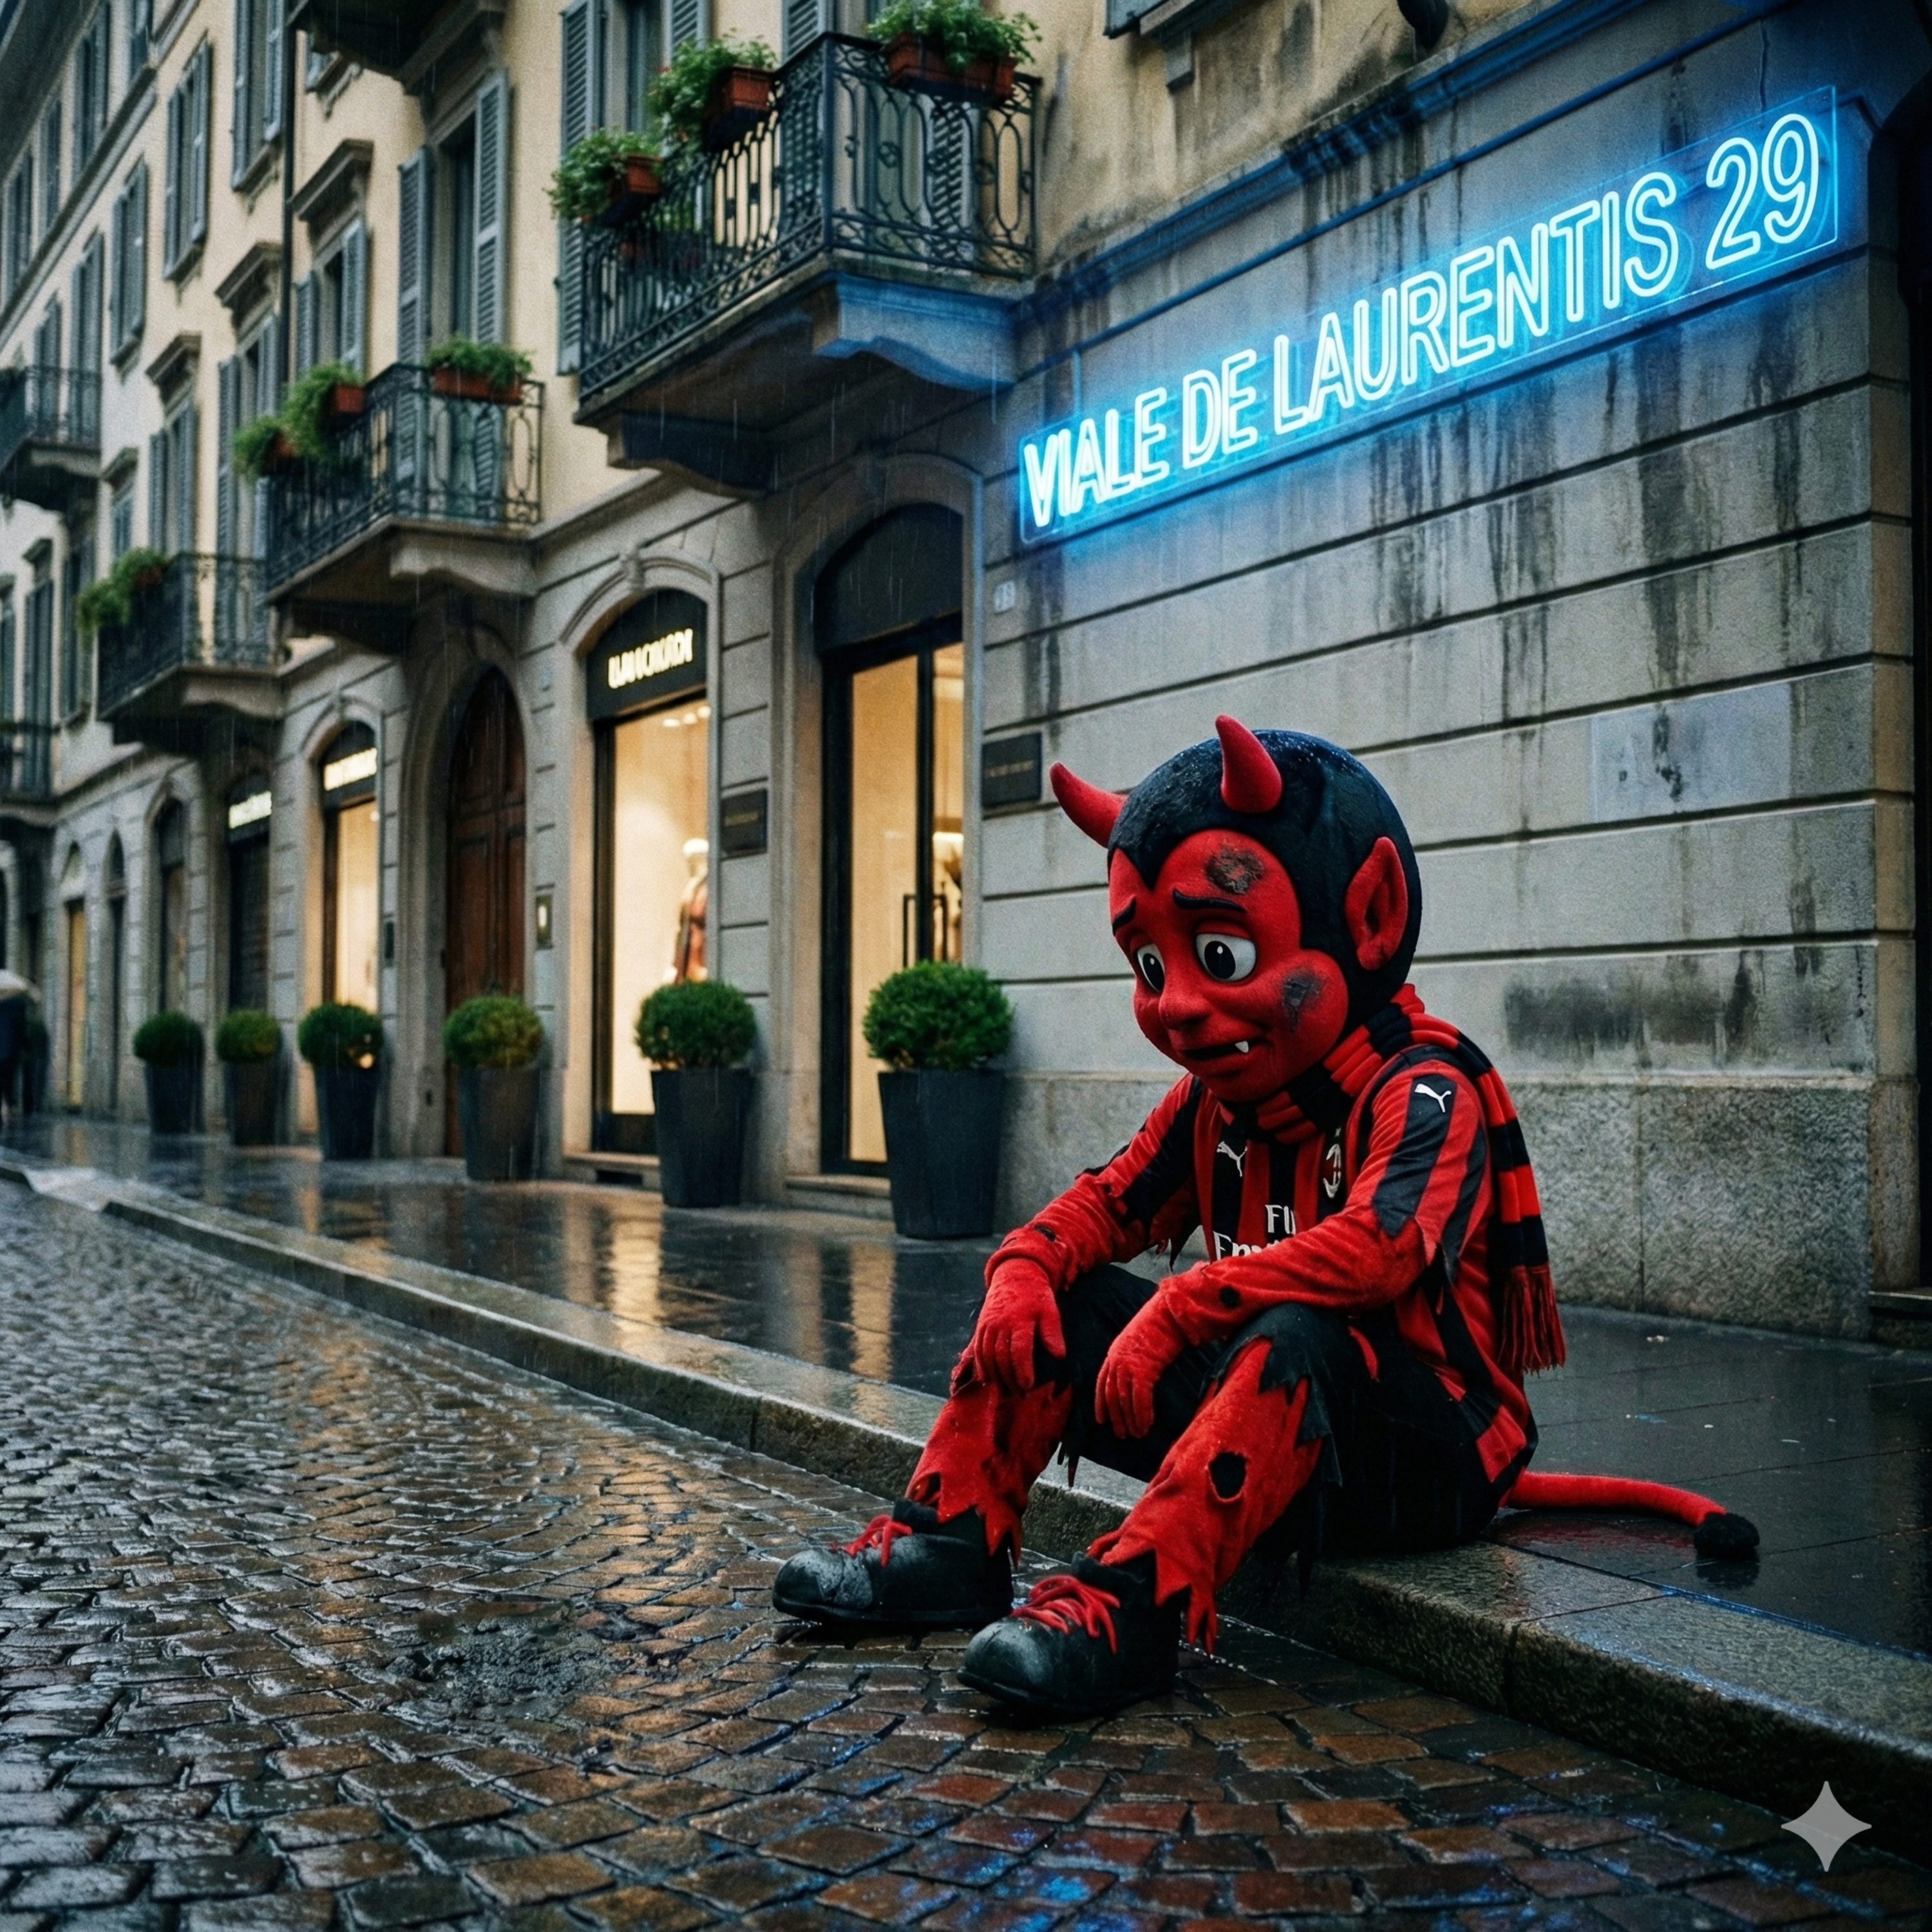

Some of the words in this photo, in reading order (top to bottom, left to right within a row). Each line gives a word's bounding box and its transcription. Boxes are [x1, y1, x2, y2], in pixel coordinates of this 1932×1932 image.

[1024, 386, 1170, 527] VIALE
[1182, 348, 1258, 469] DE
[1273, 172, 1679, 435] LAURENTIS
[1705, 113, 1819, 269] 29
